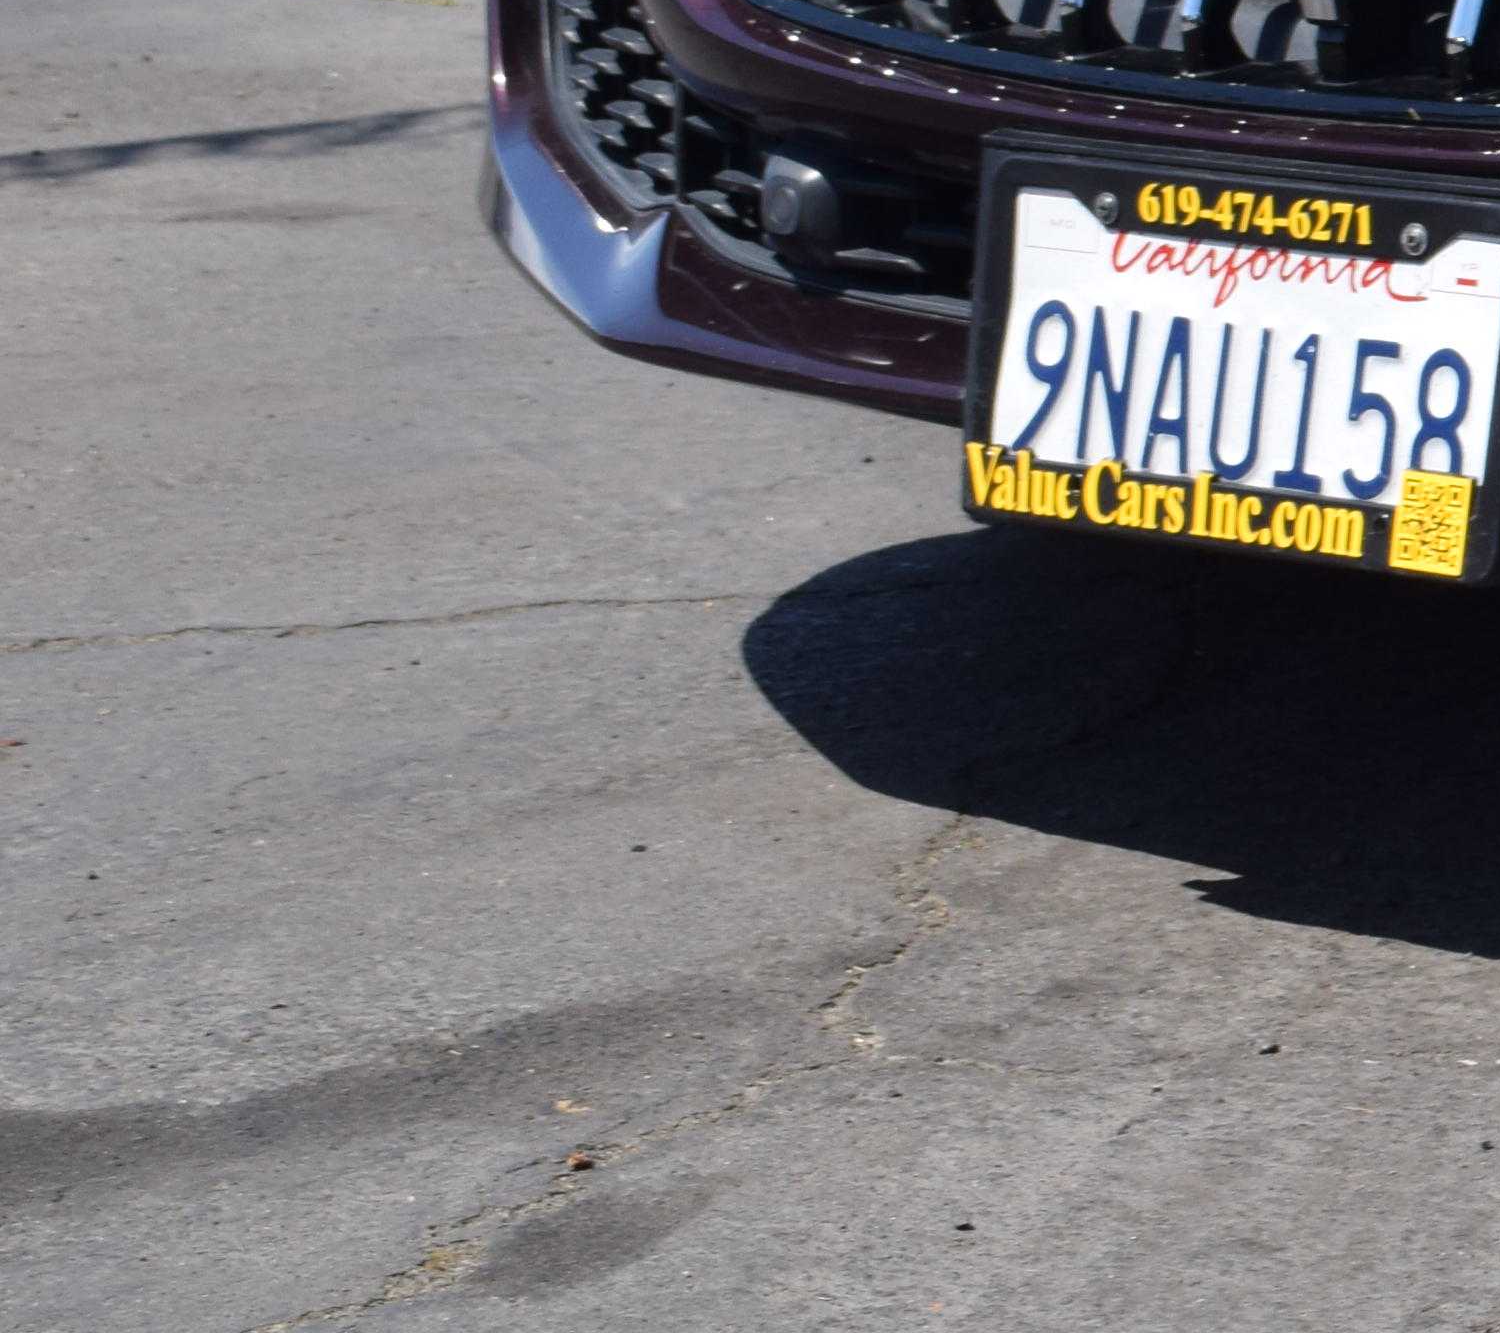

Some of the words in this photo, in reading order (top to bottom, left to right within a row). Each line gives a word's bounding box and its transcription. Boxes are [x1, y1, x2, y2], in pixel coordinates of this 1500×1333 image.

[1137, 182, 1373, 246] 619-474-6271
[1009, 299, 1471, 501] 9NAU158
[965, 441, 1077, 520] Value
[1082, 458, 1186, 534] Cars
[1189, 471, 1365, 559] Inc.com
